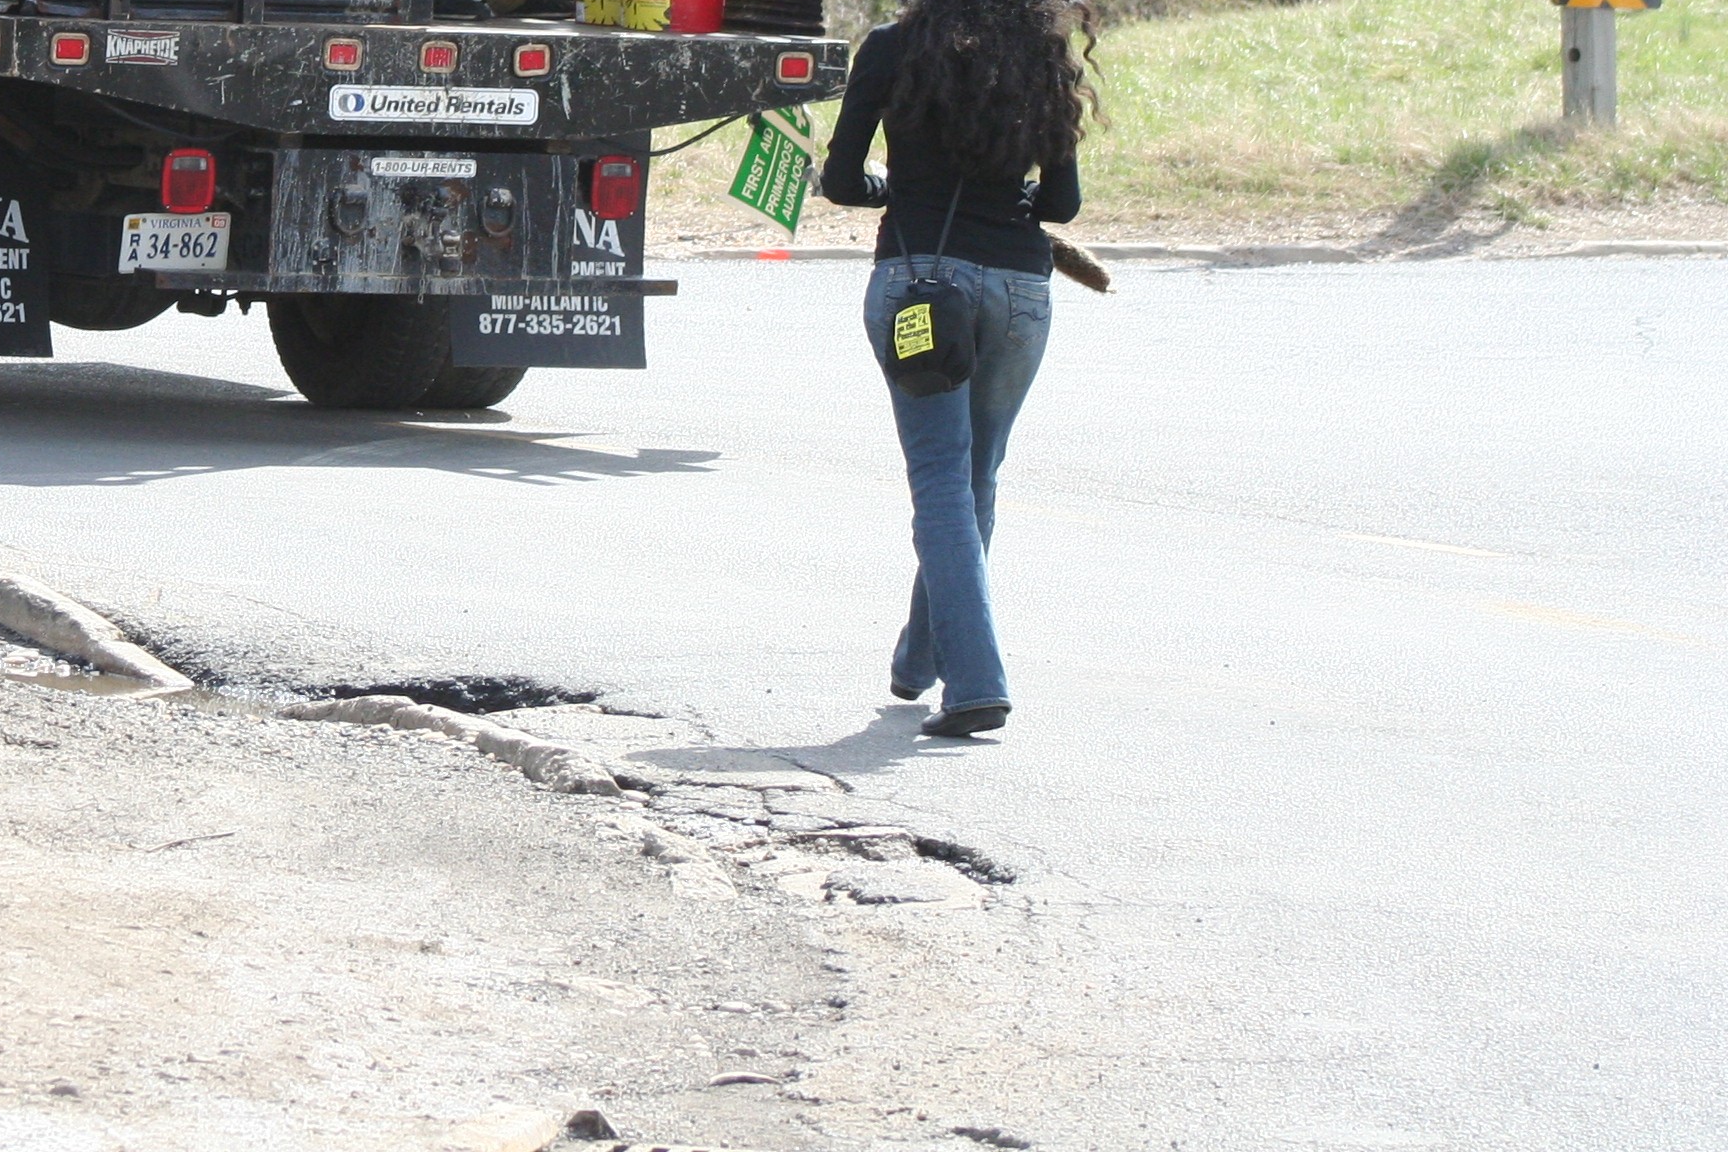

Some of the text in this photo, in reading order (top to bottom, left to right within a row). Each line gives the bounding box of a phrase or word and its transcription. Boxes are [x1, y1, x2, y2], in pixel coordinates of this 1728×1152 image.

[106, 34, 181, 61] KNAPHEIDE
[370, 94, 526, 117] United Rentals
[373, 160, 473, 176] 1-800-UR-RENTS
[741, 127, 775, 200] FIRST AID
[765, 140, 795, 217] PRIMEROS
[781, 154, 806, 222] AUXILIOS
[151, 218, 202, 229] VIRGINIA
[147, 232, 219, 259] 34-862
[491, 295, 609, 313] MID-ATLANTIC
[479, 313, 622, 336] 877-335-2621
